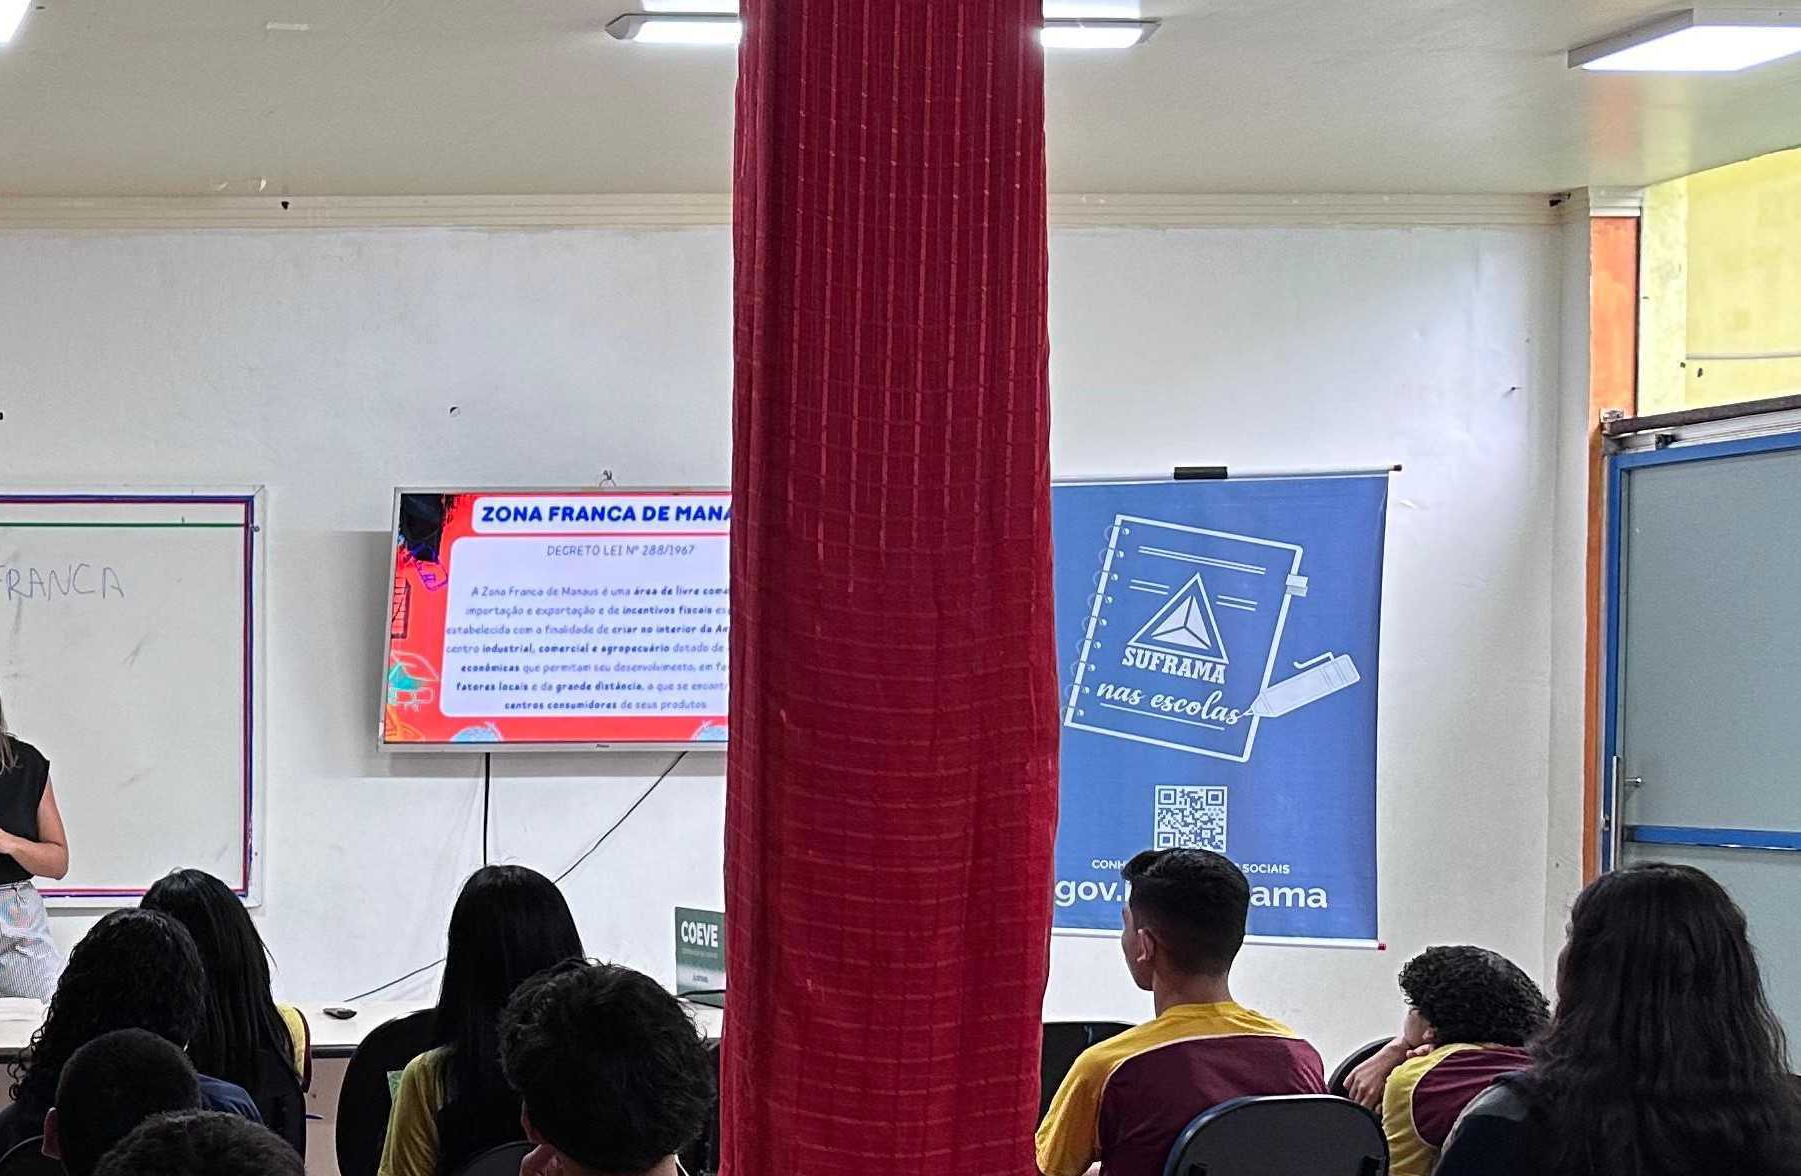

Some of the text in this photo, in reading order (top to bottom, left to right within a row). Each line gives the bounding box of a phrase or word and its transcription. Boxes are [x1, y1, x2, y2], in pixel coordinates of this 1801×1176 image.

[481, 505, 731, 522] ZONA FRANCA DE MAN
[547, 545, 600, 556] DECRETO
[603, 545, 622, 556] LEI
[642, 544, 695, 557] 288/1967
[471, 587, 478, 597] A
[482, 587, 506, 596] Zona
[509, 586, 543, 596] Franca
[546, 587, 558, 596] de
[561, 586, 599, 596] Manaus
[611, 588, 630, 596] uma
[661, 586, 672, 595] de
[676, 586, 699, 595] livre
[466, 605, 524, 618] importação
[535, 605, 595, 618] exportação
[608, 605, 619, 614] de
[623, 605, 675, 614] incentivos
[679, 605, 712, 614] fiscais
[446, 624, 510, 634] estabelecida
[545, 624, 594, 634] finalidade
[597, 624, 609, 634] de
[612, 624, 637, 633] criar
[656, 624, 696, 633] interior
[700, 624, 712, 633] da
[446, 644, 479, 653] centro
[539, 643, 588, 653] comercial
[601, 643, 670, 655] agropecuário
[673, 642, 709, 653] dotado
[711, 642, 724, 653] de
[461, 662, 520, 672] econômicas
[523, 665, 539, 674] que
[543, 664, 591, 674] permitam
[1122, 646, 1226, 685] SUFRAMA
[456, 682, 495, 691] fatores
[498, 681, 528, 691] locais
[541, 682, 553, 691] da
[556, 681, 591, 693] grande
[657, 683, 674, 691] que
[547, 700, 617, 709] consumidores
[621, 700, 632, 709] de
[1096, 682, 1244, 725] nas escolas
[1091, 859, 1126, 870] CONH
[1242, 863, 1290, 875] SOCIAIS
[681, 920, 718, 947] COEVE
